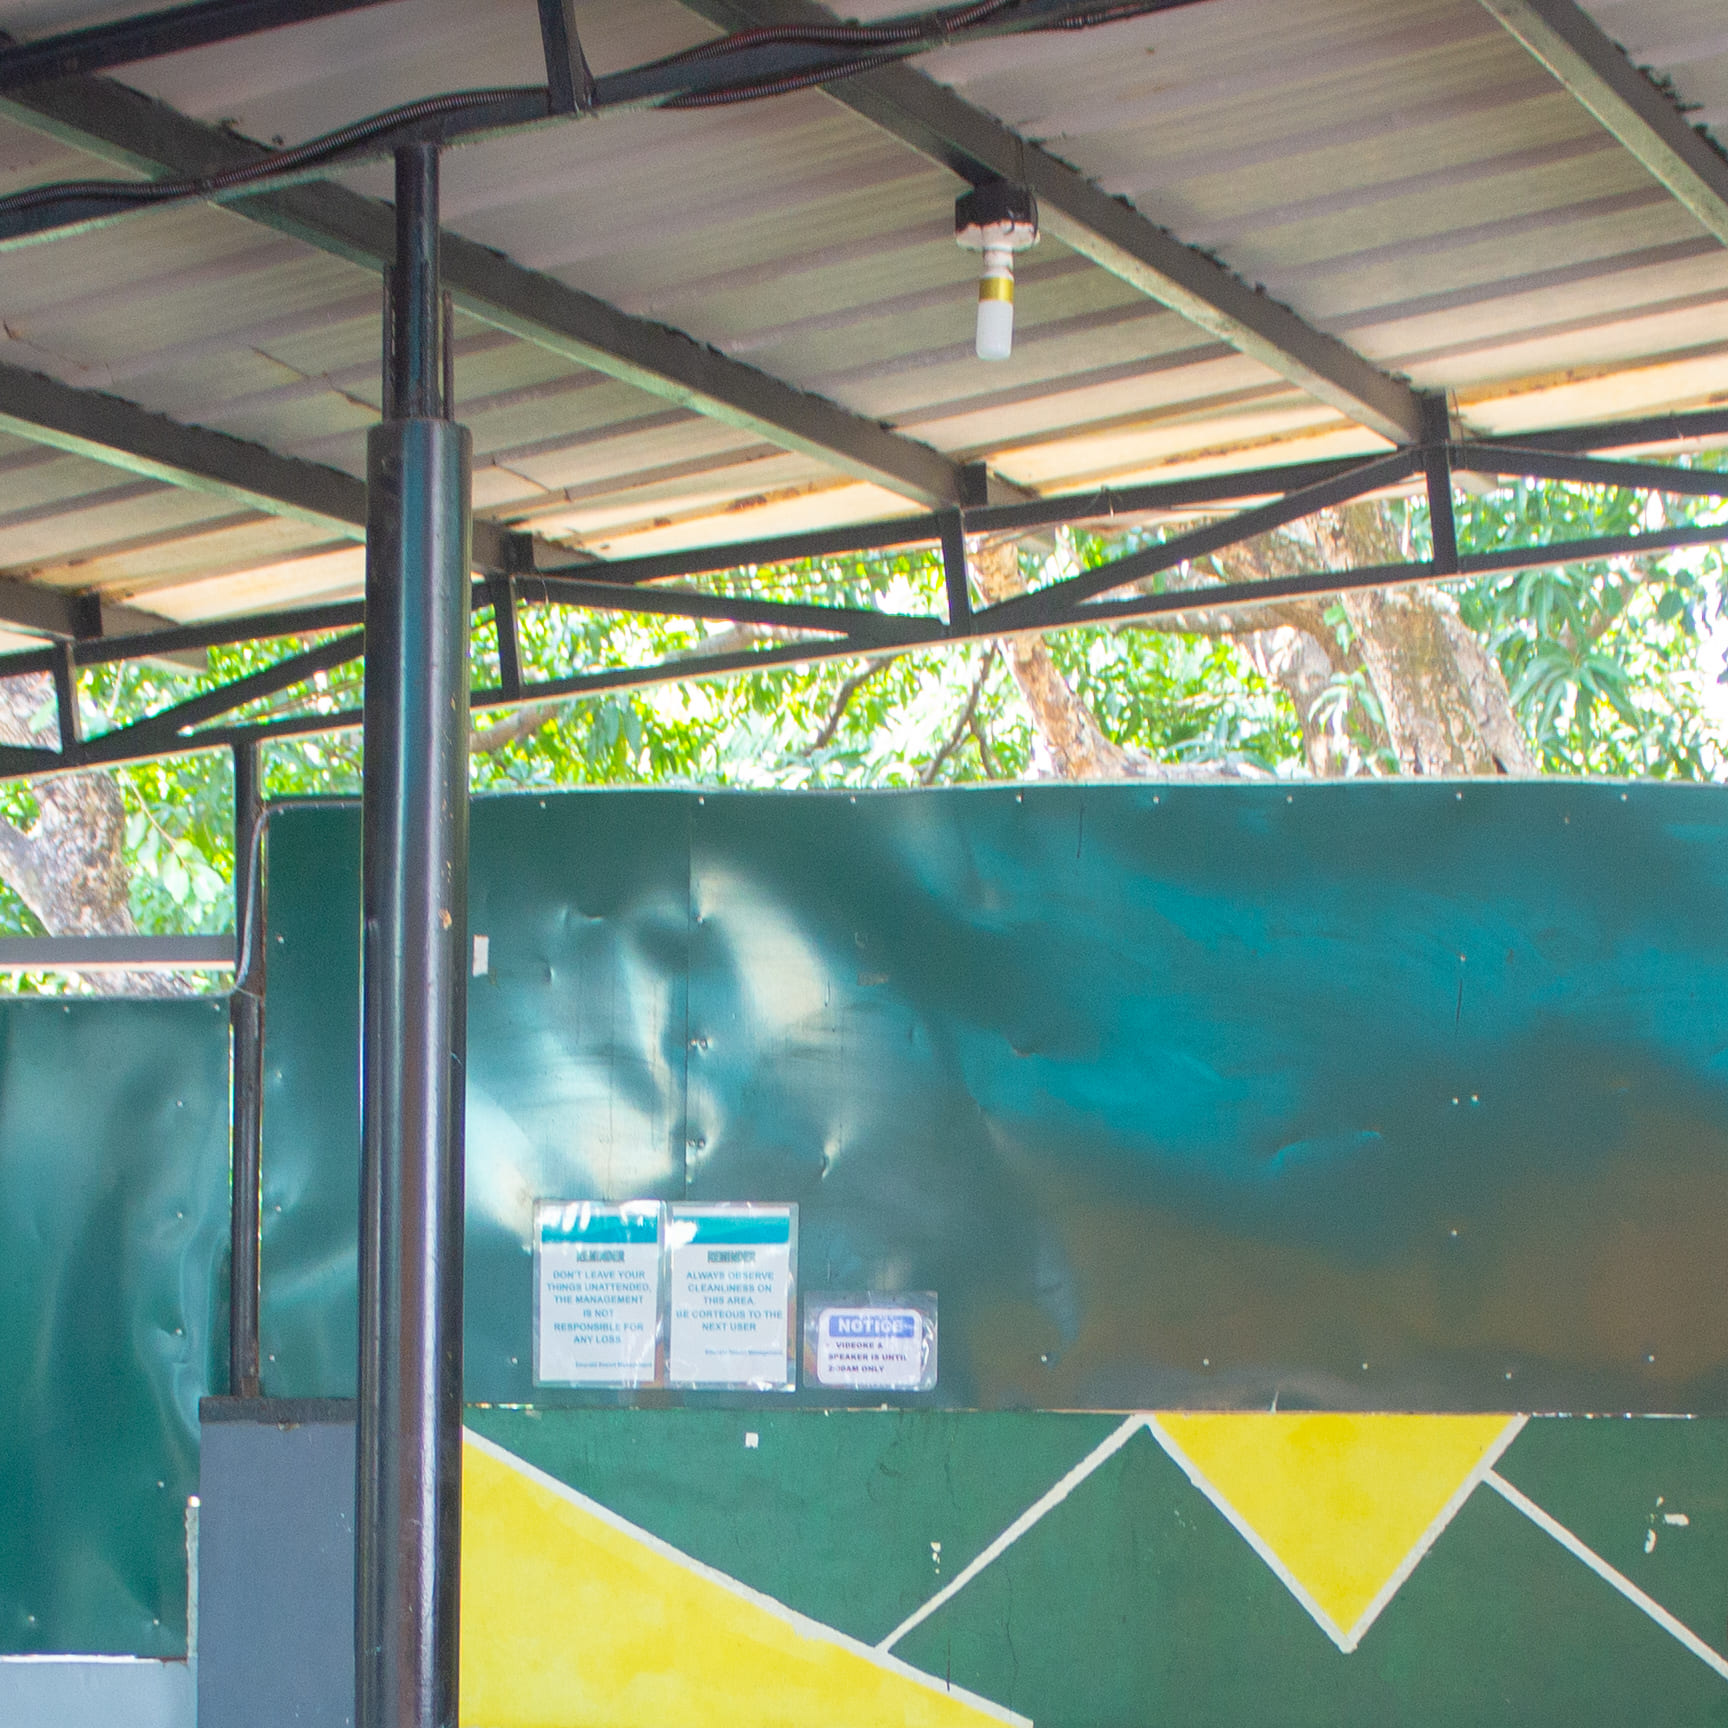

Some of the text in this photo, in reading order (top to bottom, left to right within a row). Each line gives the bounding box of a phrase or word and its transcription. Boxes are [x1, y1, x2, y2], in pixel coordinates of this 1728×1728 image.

[553, 1270, 646, 1280] DON'T LEAVE YOUR
[686, 1271, 775, 1280] ALWAYS OBSERVE
[547, 1283, 582, 1291] THINGS
[688, 1284, 773, 1293] CLEANLINESS ON
[553, 1295, 643, 1304] THE MANAGEMENT
[703, 1296, 724, 1305] THIS
[583, 1308, 614, 1318] IS NOT
[749, 1310, 762, 1319] TO
[763, 1310, 783, 1319] THE
[553, 1322, 644, 1331] RESPONSIBLE FOR
[702, 1322, 757, 1331] NEXT USER
[838, 1318, 903, 1334] NOTICE
[573, 1334, 622, 1344] ANY LOSS
[835, 1341, 874, 1349] VIDEOKE
[828, 1353, 907, 1361] SPEAKER IS UNTIL
[861, 1365, 885, 1373] ONLY
